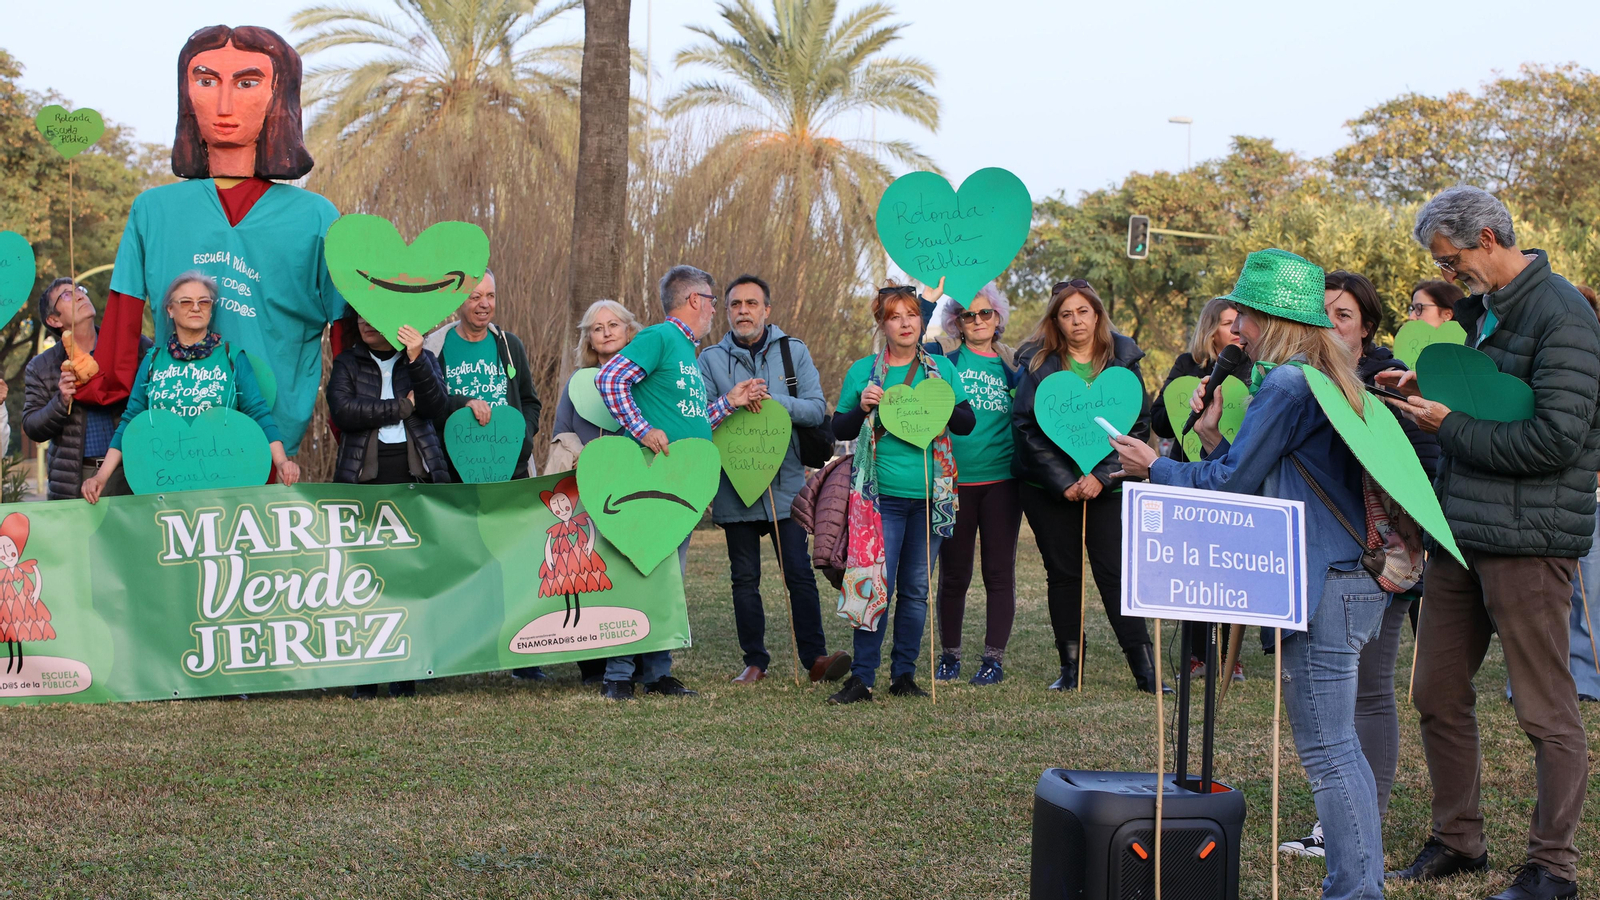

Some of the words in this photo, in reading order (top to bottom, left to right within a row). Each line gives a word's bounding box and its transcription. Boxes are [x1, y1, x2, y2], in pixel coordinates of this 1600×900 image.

[892, 192, 995, 225] Rotonda:
[904, 223, 983, 250] Escuela
[193, 251, 230, 266] ESCUELA
[912, 249, 989, 273] Pública
[220, 297, 257, 318] TOD@S
[152, 364, 189, 382] ESCUELA
[191, 366, 228, 382] PÚBLICA
[446, 361, 482, 379] ESCUELA
[1043, 385, 1122, 419] Rotonda
[453, 420, 520, 445] Rotonda:
[725, 415, 786, 437] Rotonda:
[1054, 410, 1093, 437] Escuel
[149, 430, 244, 461] Rotonda:
[456, 443, 508, 467] Escuela
[727, 435, 781, 455] Escuela
[729, 457, 775, 471] Pública
[1172, 504, 1255, 528] ROTONDA
[160, 503, 416, 561] MAREA
[1146, 538, 1174, 564] De
[1183, 541, 1200, 566] la
[1208, 543, 1286, 575] Escuela
[202, 548, 382, 619] Verde
[1170, 578, 1248, 609] Pública
[599, 619, 638, 631] ESCUELA
[185, 611, 407, 673] JEREZ
[516, 636, 575, 650] ENAMORAD@S
[577, 634, 588, 643] de
[589, 633, 598, 641] la
[599, 629, 638, 640] PÚBLICA
[20, 681, 31, 689] de
[42, 679, 79, 689] PÚBLICA
[41, 670, 80, 680] ESCUELA
